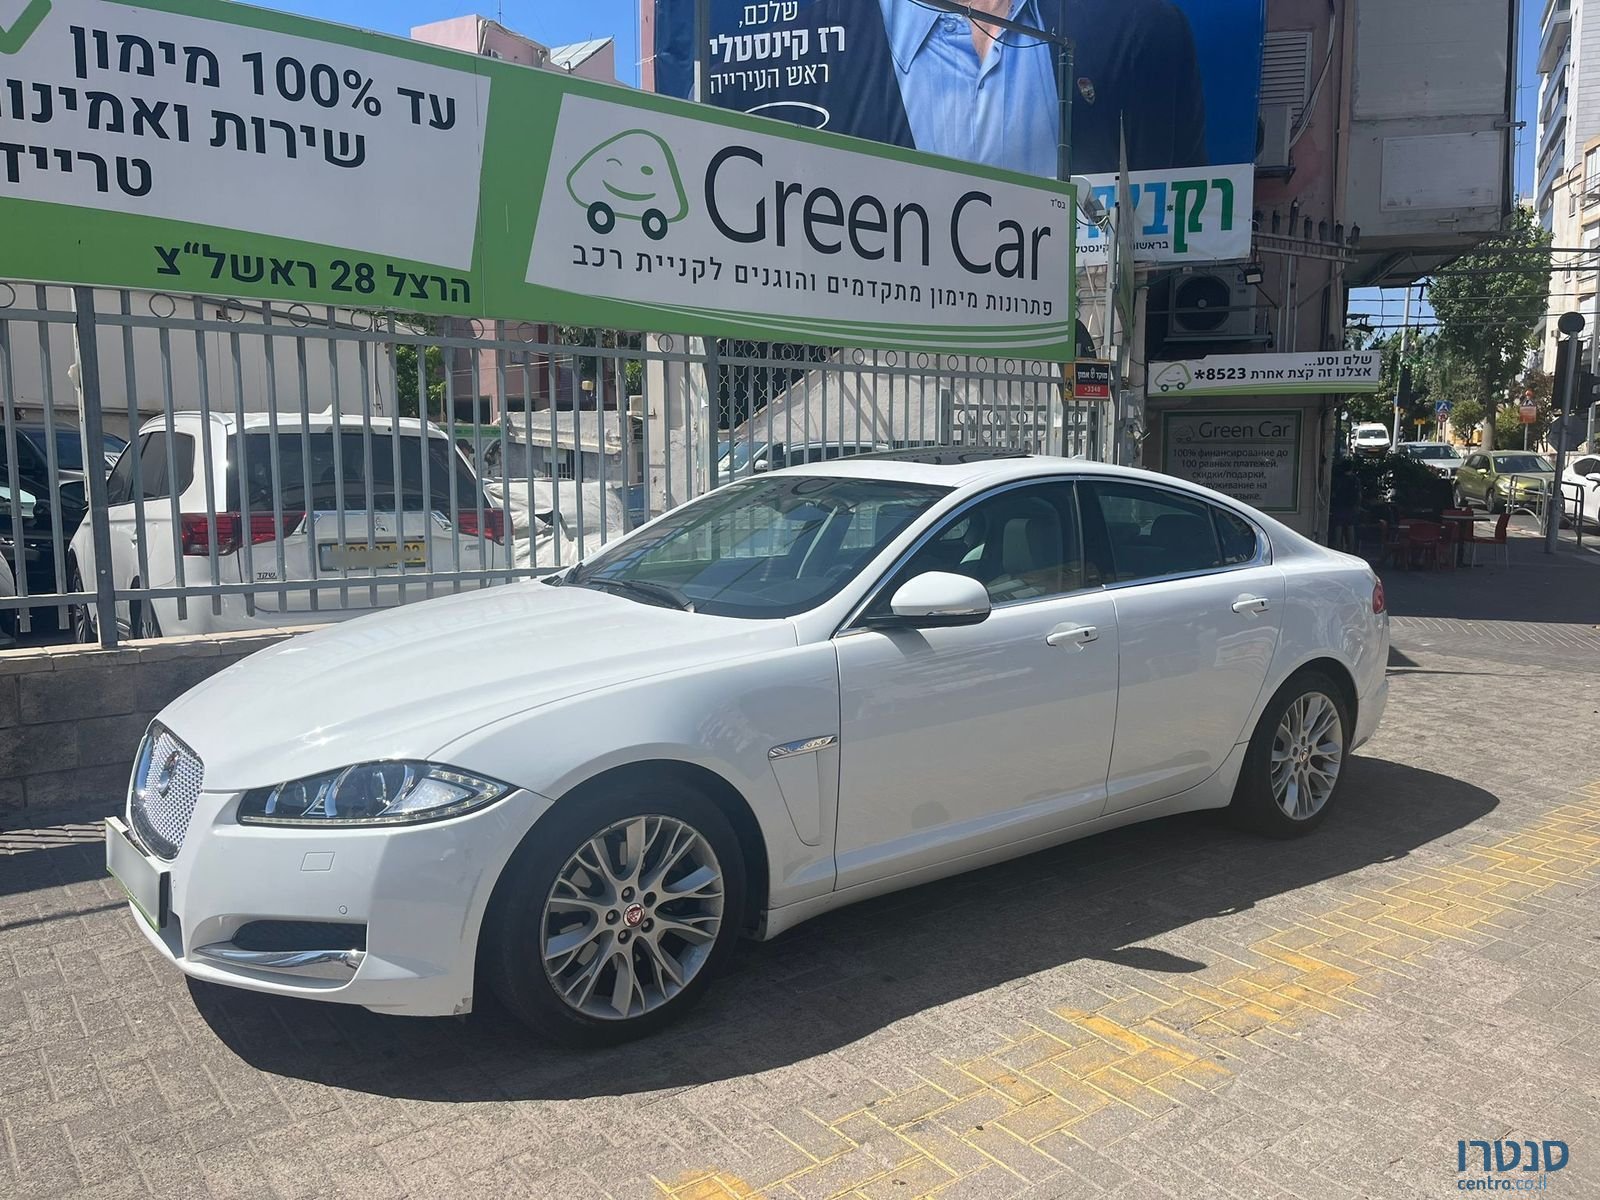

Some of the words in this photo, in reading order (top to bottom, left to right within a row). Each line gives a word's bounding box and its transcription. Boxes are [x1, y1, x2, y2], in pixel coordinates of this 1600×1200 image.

[738, 1, 798, 28] שלכם,
[818, 26, 845, 53] רז
[70, 25, 220, 88] מימון
[242, 51, 383, 117] 100%
[710, 67, 780, 95] העירייה
[786, 64, 829, 87] ראש
[0, 78, 190, 142] ואמינו
[397, 86, 457, 131] עד
[209, 109, 366, 168] שירות
[704, 145, 930, 267] Green
[949, 190, 1051, 281] Car
[572, 244, 623, 269] רכב
[1132, 240, 1169, 250] בראשו
[328, 259, 376, 294] 28
[635, 252, 723, 284] לקניית
[735, 264, 816, 292] והוגנים
[386, 264, 471, 304] הרצל
[827, 275, 921, 304] מתקדמים
[930, 287, 978, 309] מימון
[985, 294, 1052, 317] פתרונות
[1318, 367, 1331, 378] זה
[1335, 366, 1372, 377] אצלנו
[1343, 354, 1373, 365] שלם
[1250, 369, 1284, 380] אחרת
[1287, 368, 1314, 381] קצת
[1199, 421, 1254, 438] Green
[1258, 420, 1291, 438] Car
[1173, 448, 1196, 457] 100%
[1198, 447, 1275, 458] финансирование
[1276, 449, 1289, 458] до
[1182, 460, 1197, 468] 100
[1257, 482, 1268, 490] на
